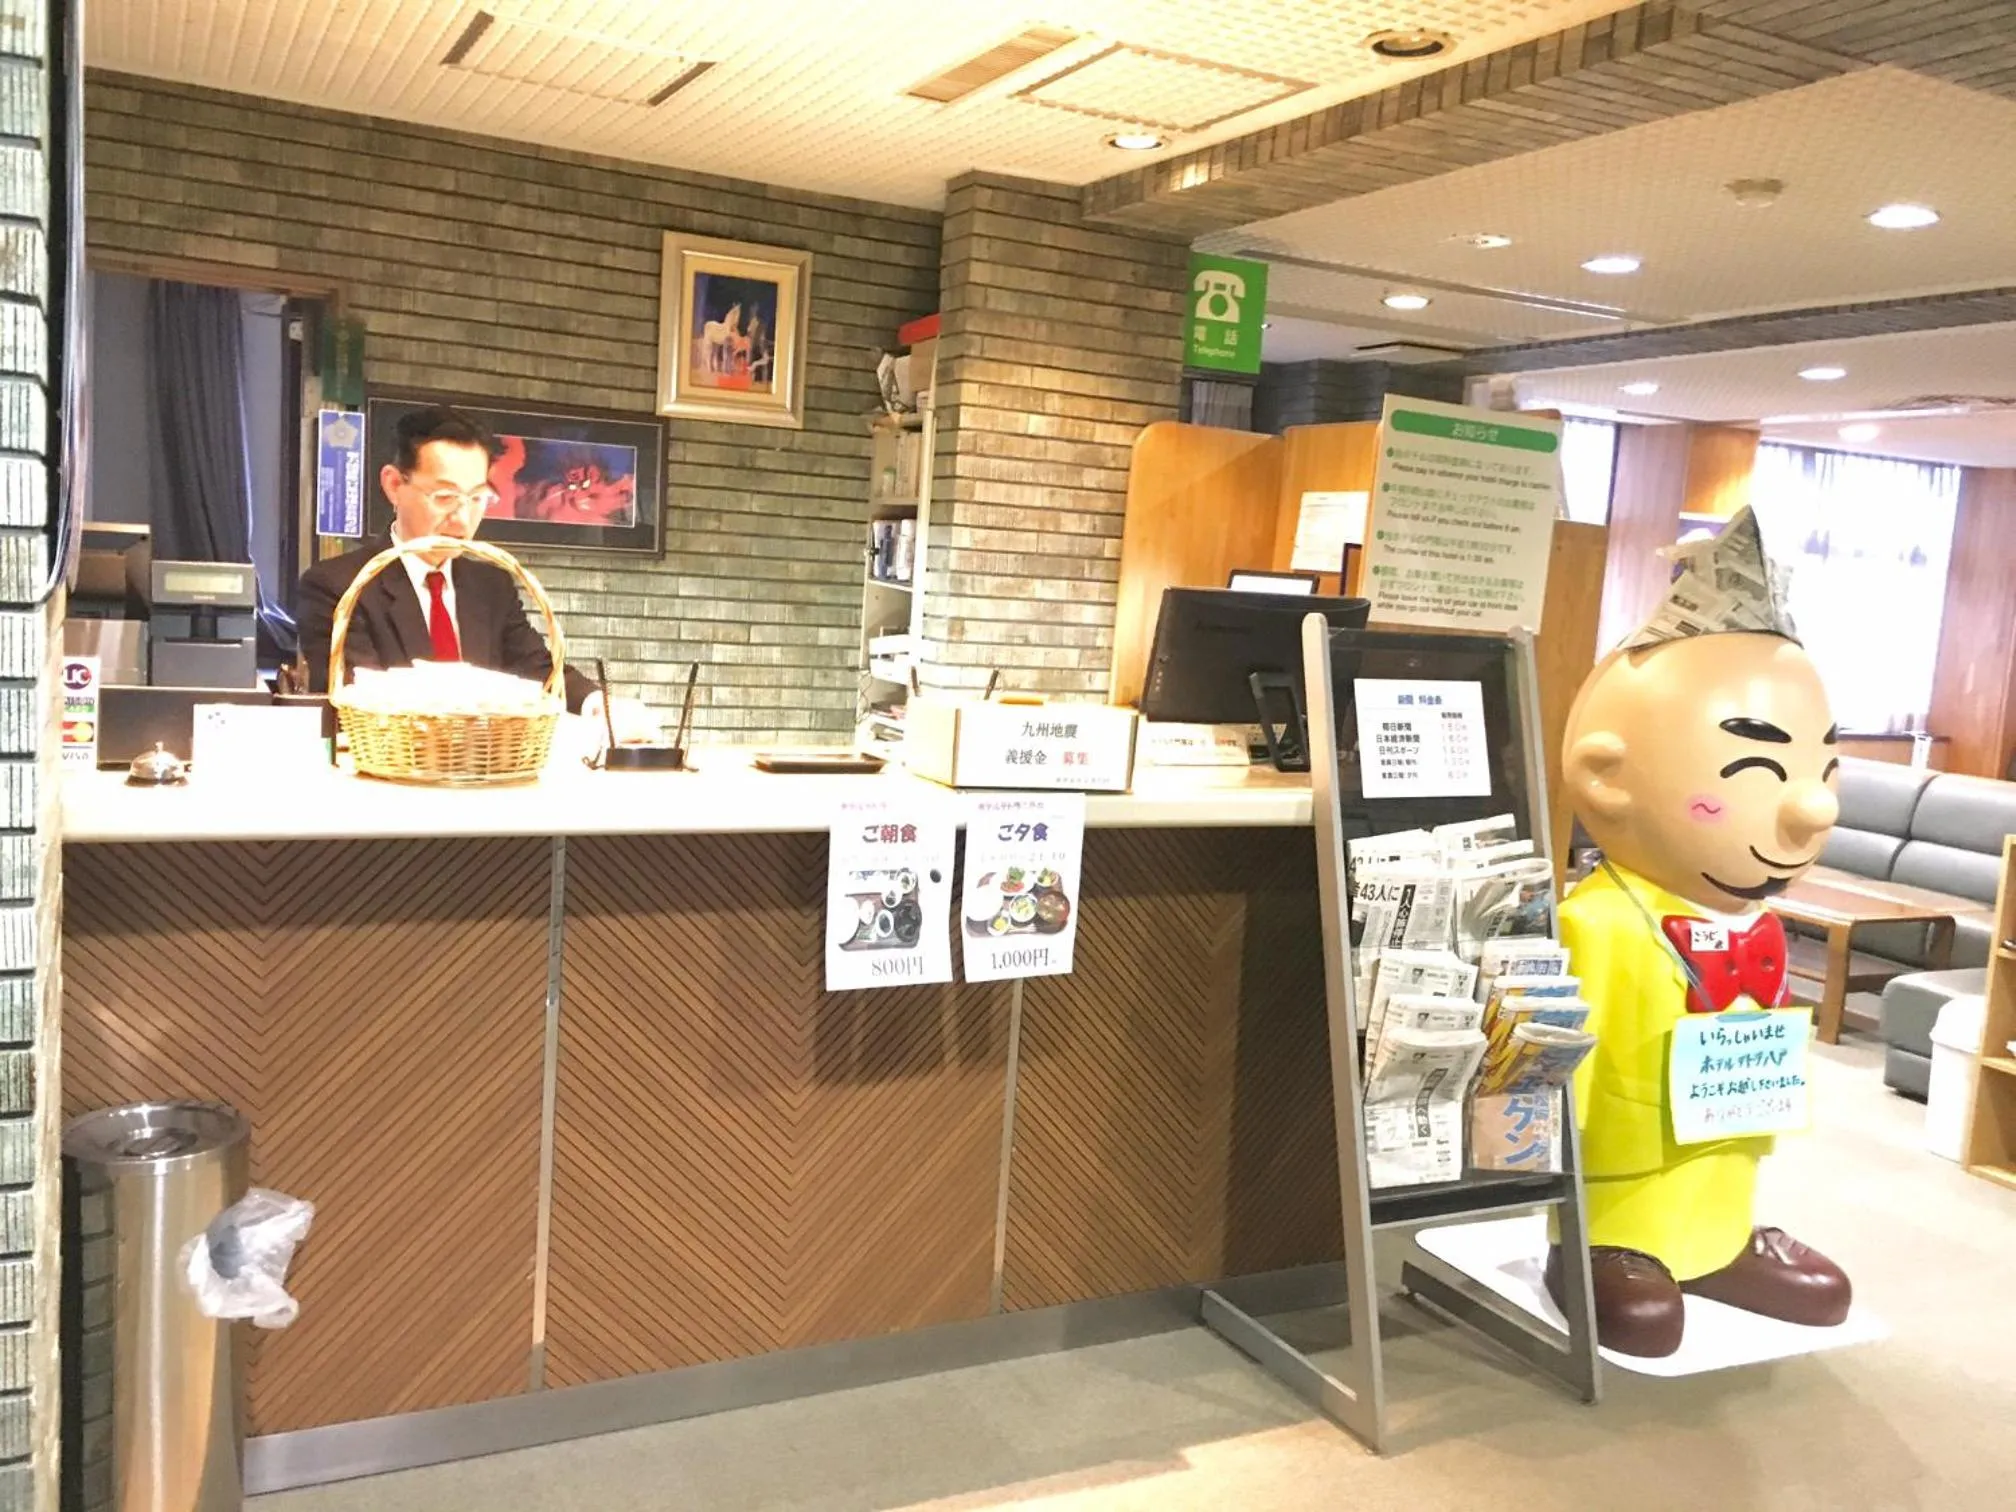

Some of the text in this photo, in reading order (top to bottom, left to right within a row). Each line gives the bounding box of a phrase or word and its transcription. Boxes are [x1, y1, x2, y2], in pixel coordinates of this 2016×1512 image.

[1021, 721, 1078, 739] 九州地震
[1005, 749, 1048, 765] 義援金
[1379, 745, 1419, 755] 日刊スポーツ
[862, 823, 918, 844] ご朝食
[997, 822, 1049, 843] ご夕食
[871, 954, 923, 978] 800円
[1700, 1024, 1786, 1046] いらっしゃいませ
